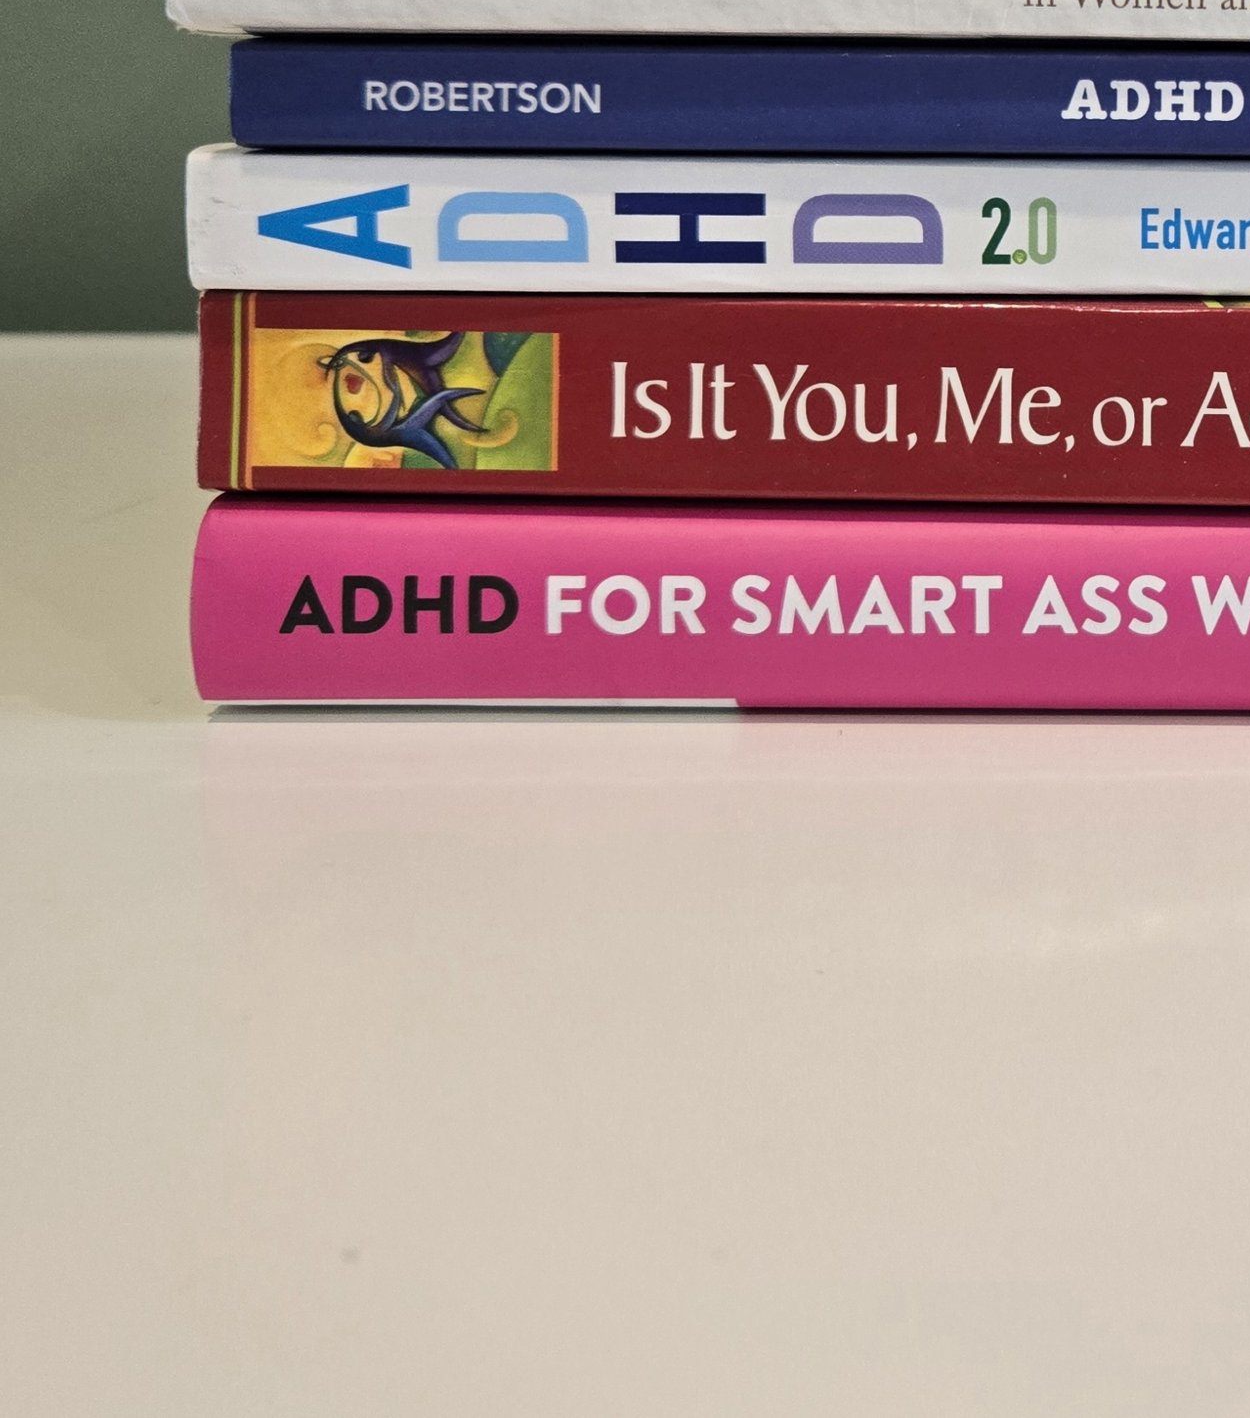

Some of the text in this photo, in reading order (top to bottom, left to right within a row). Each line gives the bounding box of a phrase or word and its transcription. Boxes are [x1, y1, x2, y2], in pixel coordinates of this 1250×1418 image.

[365, 81, 600, 113] ROBERTSON
[1061, 79, 1244, 121] ADHD
[982, 198, 1055, 264] 2.0
[612, 362, 671, 438] Is
[689, 363, 736, 439] It
[753, 364, 917, 450] You,
[935, 367, 1074, 452] Me,
[1093, 397, 1167, 446] or
[279, 575, 519, 634] ADHD
[547, 575, 706, 634] FOR
[732, 575, 1002, 634] SMART
[1022, 575, 1167, 634] ASS
